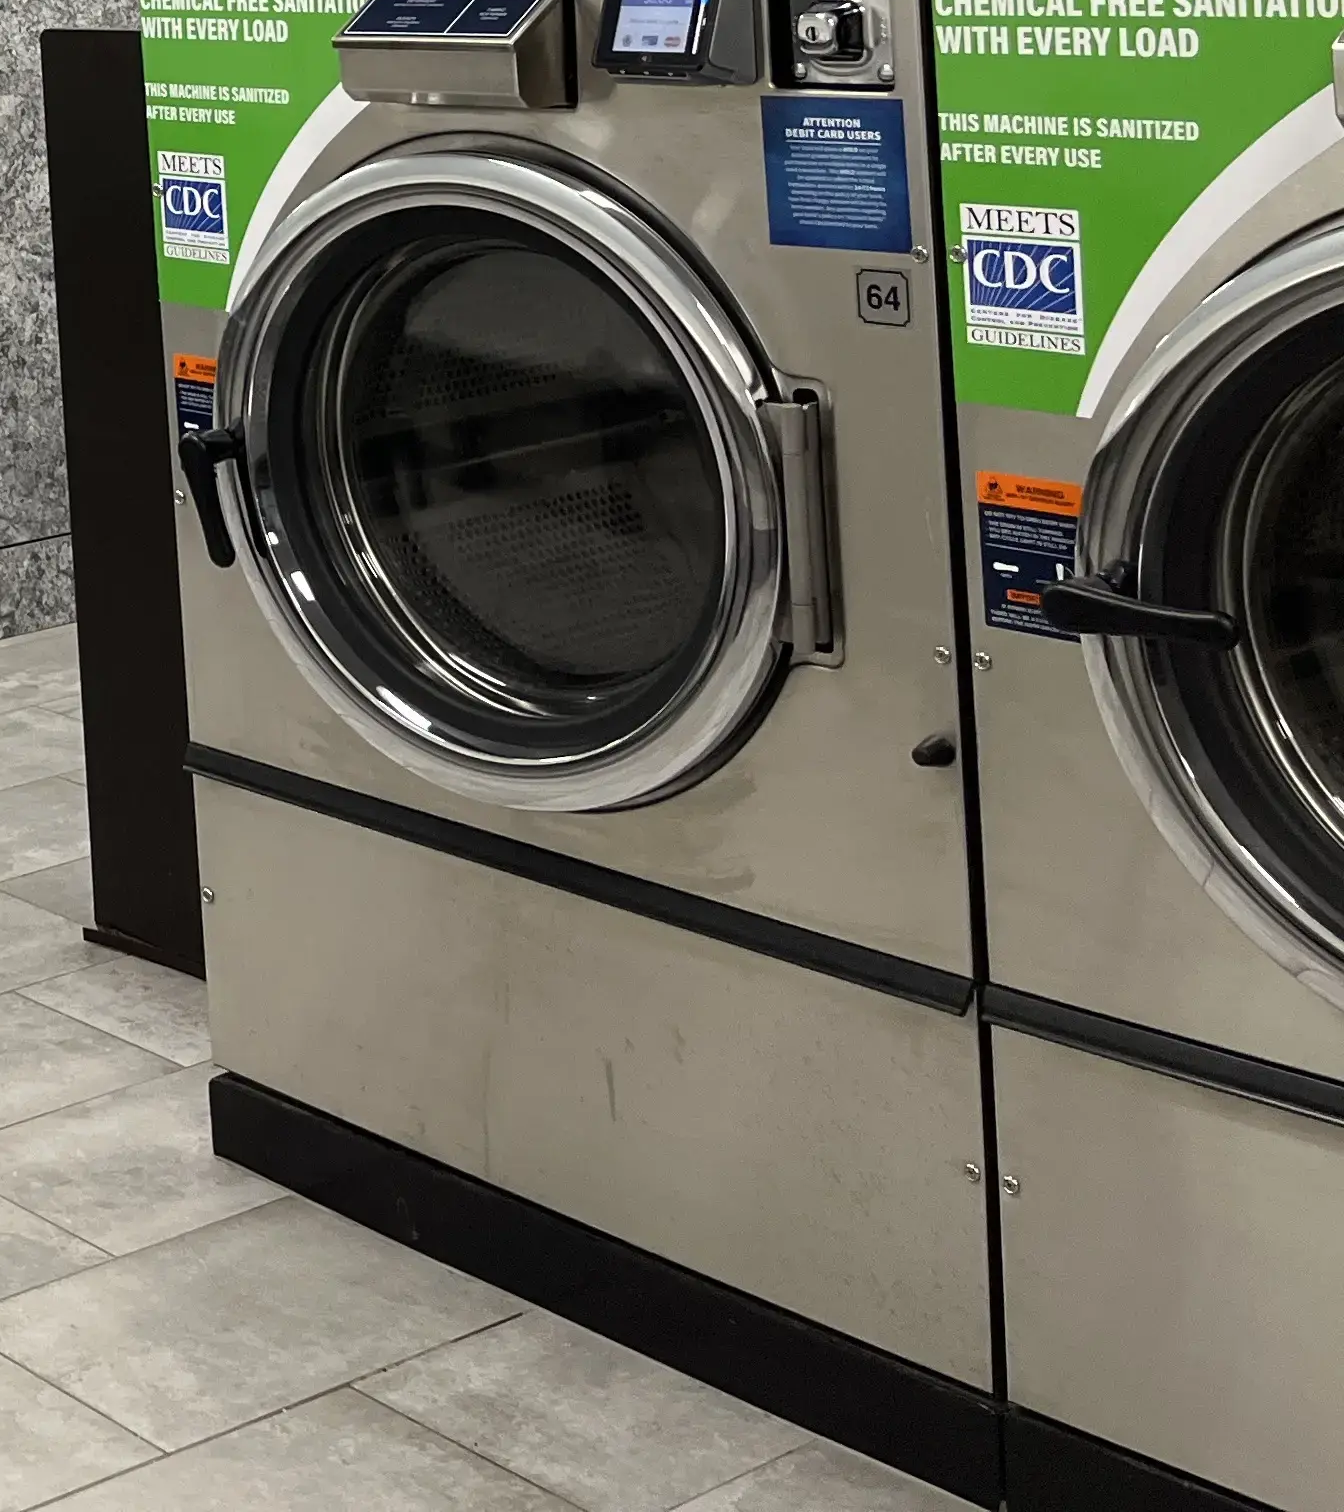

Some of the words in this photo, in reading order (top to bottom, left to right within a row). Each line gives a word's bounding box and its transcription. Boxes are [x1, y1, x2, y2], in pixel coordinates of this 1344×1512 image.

[141, 16, 183, 40] WITH
[186, 17, 240, 42] EVERY
[243, 19, 289, 43] LOAD
[935, 25, 1010, 56] WITH
[1017, 26, 1112, 57] EVERY
[1119, 27, 1199, 58] LOAD
[144, 82, 168, 98] THIS
[169, 83, 218, 101] MACHINE
[219, 86, 231, 101] IS
[232, 86, 291, 105] SANITIZED
[146, 104, 178, 122] AFTER
[179, 106, 214, 124] EVERY
[214, 108, 236, 125] USE
[802, 117, 861, 128] ATTENTION
[938, 112, 979, 133] THIS
[983, 114, 1068, 137] MACHINE
[1073, 117, 1092, 137] IS
[1096, 117, 1200, 141] SANITIZED
[785, 128, 815, 138] DEBIT
[817, 129, 845, 140] CARD
[847, 130, 882, 141] USERS
[161, 153, 222, 176] MEETS
[939, 142, 997, 164] AFTER
[1000, 145, 1060, 166] EVERY
[1063, 148, 1102, 168] USE
[165, 185, 221, 219] CDC
[966, 207, 1076, 237] MEETS
[166, 246, 228, 263] GUIDELINES
[972, 249, 1070, 294] CDC
[866, 283, 901, 312] 64
[971, 328, 1081, 353] GUIDELINES
